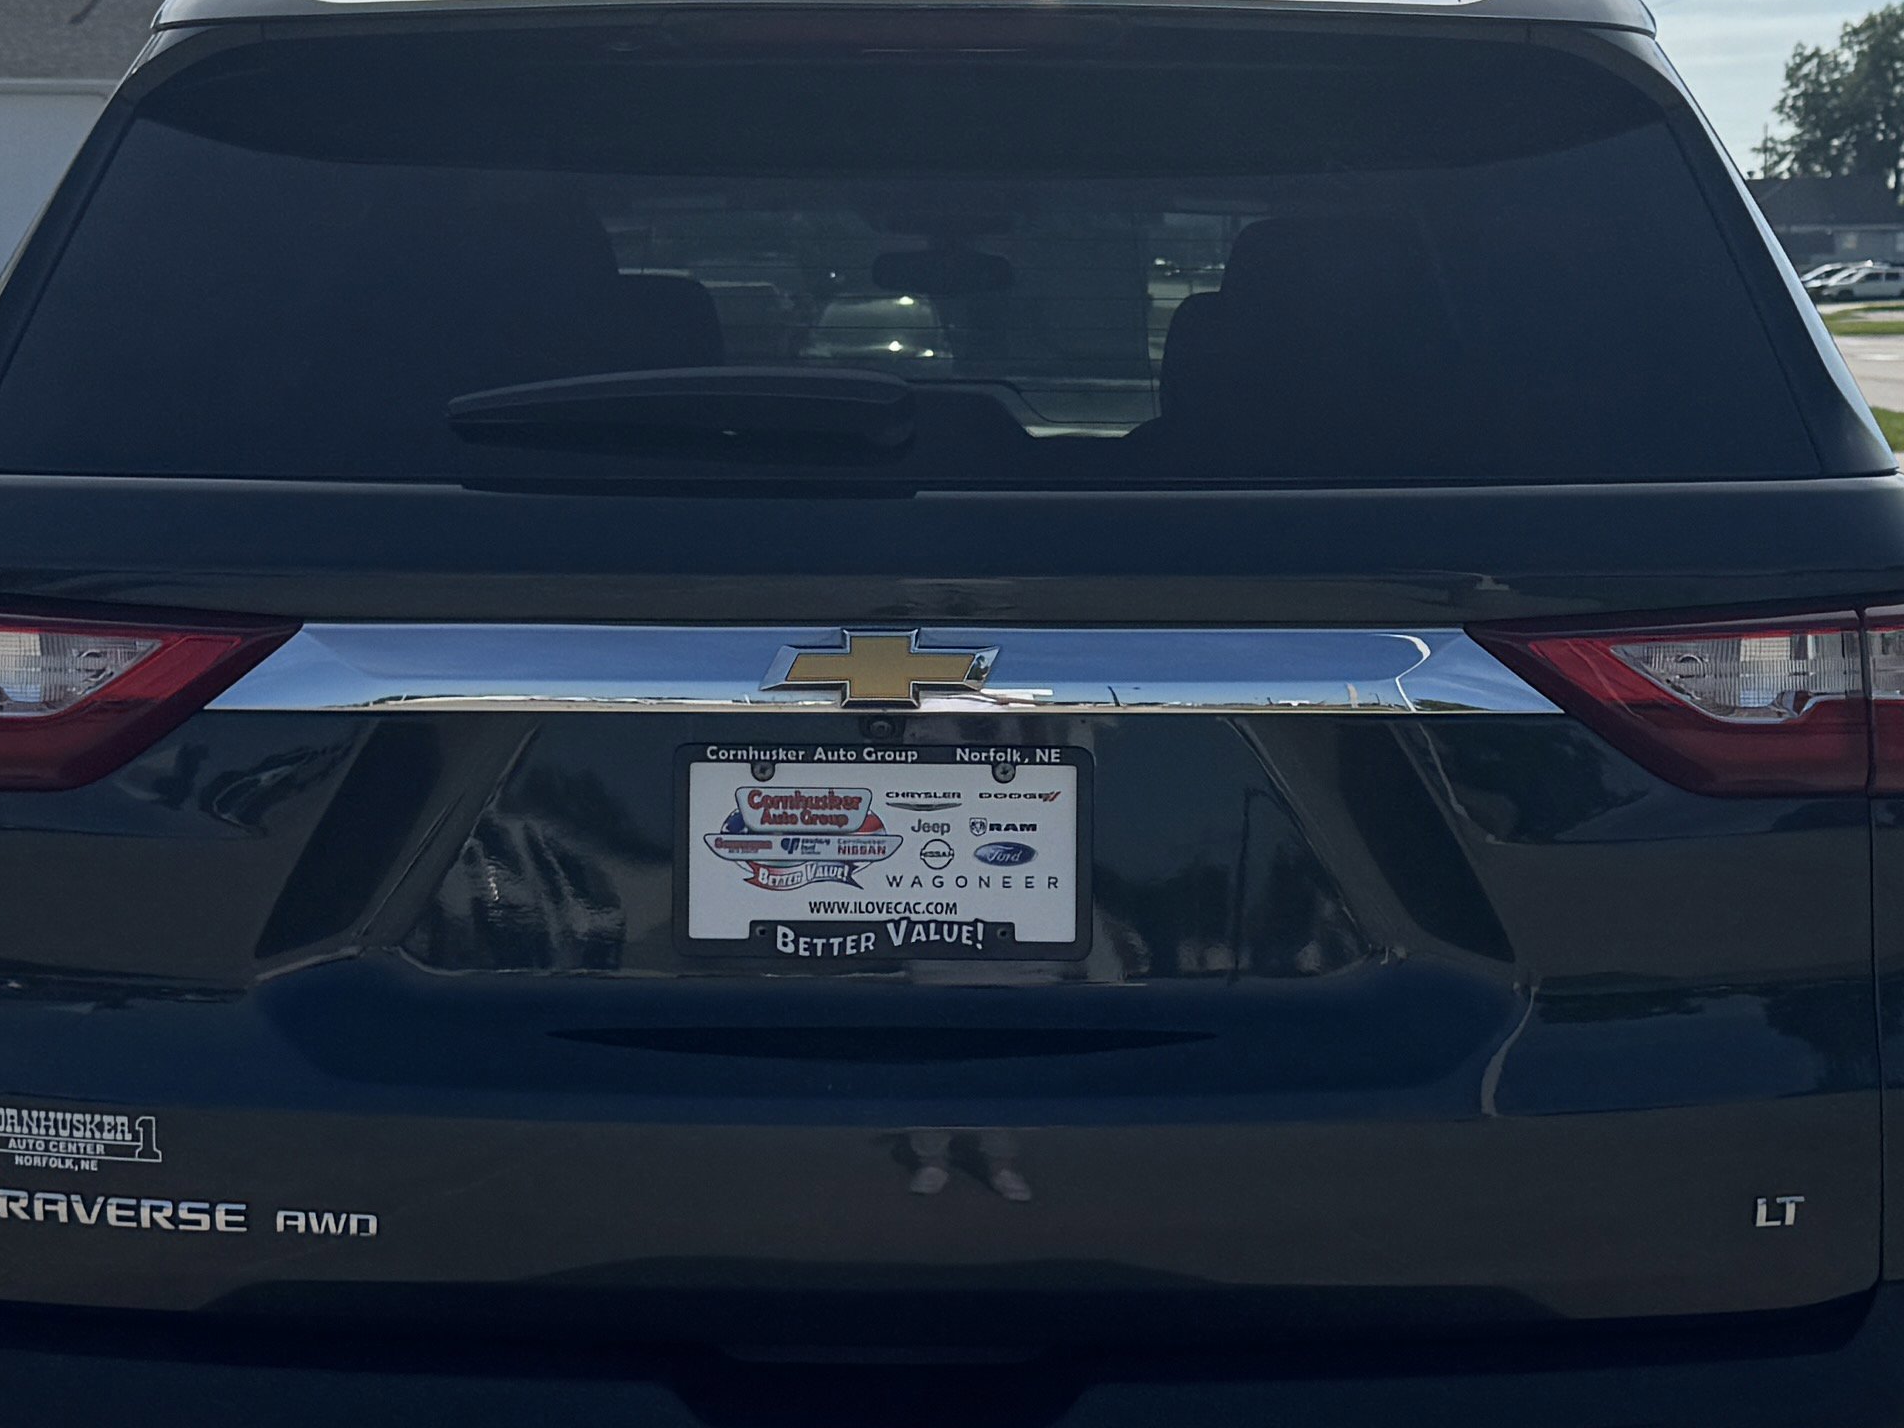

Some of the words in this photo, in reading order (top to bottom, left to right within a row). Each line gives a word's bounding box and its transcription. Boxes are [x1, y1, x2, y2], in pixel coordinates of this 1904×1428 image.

[706, 746, 805, 762] Cornhusker
[814, 747, 857, 762] Auto
[863, 747, 918, 763] Group
[956, 747, 1029, 764] Norfolk,
[1036, 749, 1060, 762] NE
[748, 789, 863, 811] Cornhusker
[885, 791, 962, 799] CHRYSLER
[978, 791, 1051, 801] DODGE
[760, 810, 798, 825] Auto
[800, 809, 849, 828] Group
[911, 819, 951, 836] Jeep
[989, 823, 1037, 832] RAM
[986, 845, 1023, 862] Ford
[885, 875, 1059, 889] WAGONEER
[809, 900, 958, 916] WWW.ILOVECAC.COM
[776, 925, 875, 958] BETTER
[886, 918, 984, 950] VALUE!
[8, 1138, 45, 1151] AUTO
[49, 1140, 105, 1155] CENTER
[135, 1116, 162, 1163] 1
[15, 1155, 79, 1172] NORFOLK,
[80, 1159, 98, 1171] NE
[1756, 1196, 1805, 1227] LT
[276, 1210, 379, 1236] AWD
